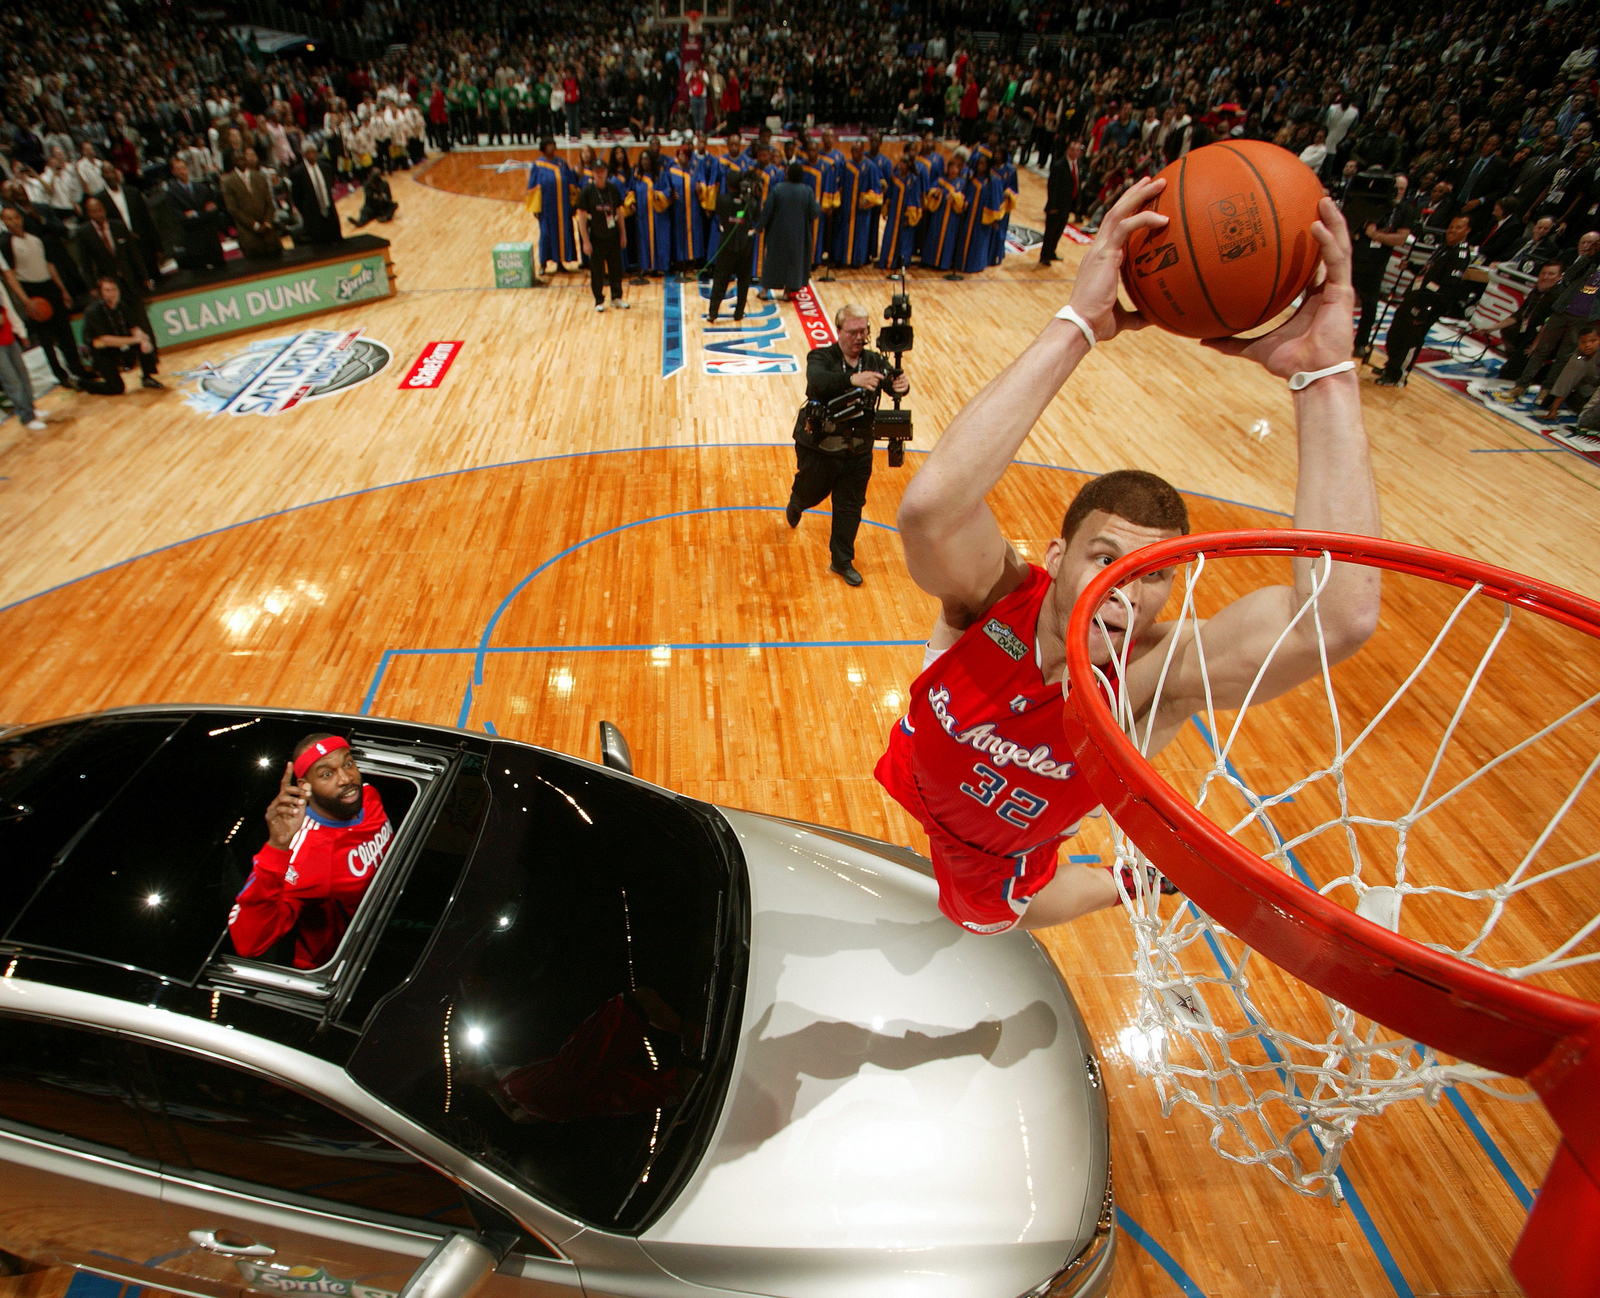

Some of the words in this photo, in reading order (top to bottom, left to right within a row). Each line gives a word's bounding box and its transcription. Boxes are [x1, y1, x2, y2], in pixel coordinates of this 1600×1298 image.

[339, 269, 374, 299] Sprite
[162, 296, 241, 337] SLAM
[245, 278, 321, 317] DUNK
[806, 320, 833, 348] LOS
[997, 636, 1022, 661] DUNK
[1009, 636, 1028, 653] SLAM
[928, 684, 958, 737] Los
[954, 722, 1076, 780] Angeles
[960, 762, 1049, 830] 32
[260, 1272, 348, 1295] Sprite
